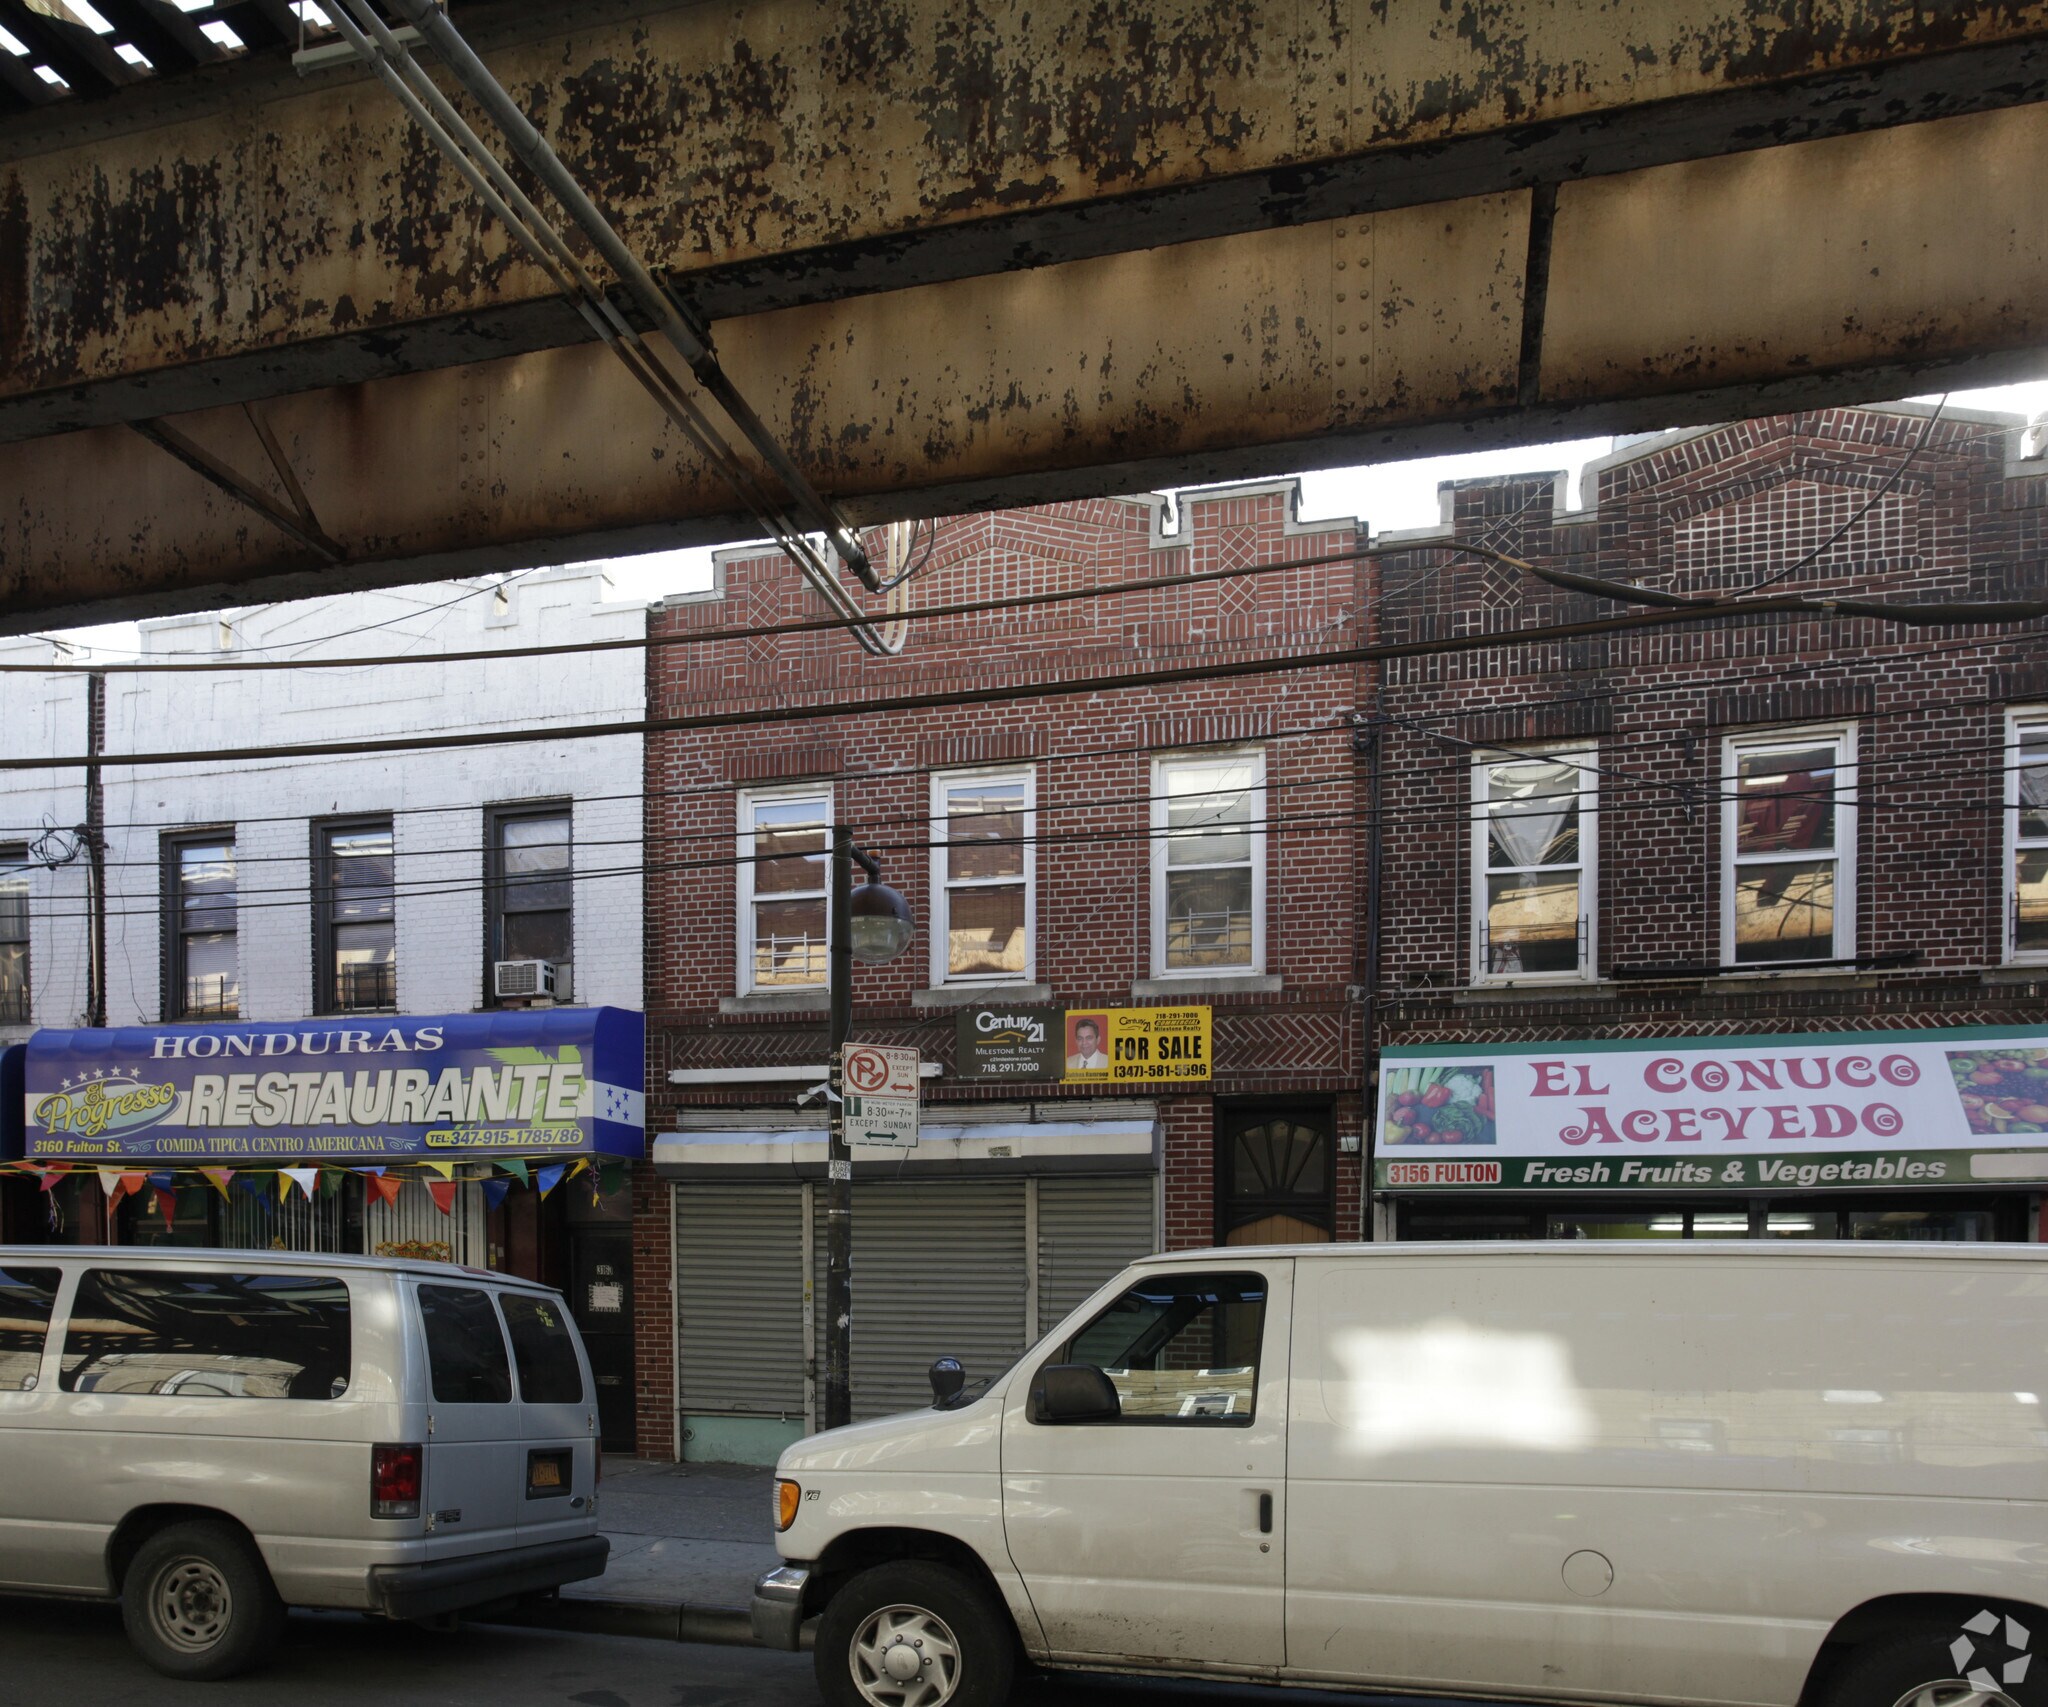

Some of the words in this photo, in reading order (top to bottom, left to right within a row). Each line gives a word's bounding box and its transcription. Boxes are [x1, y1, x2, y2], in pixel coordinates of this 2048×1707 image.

[975, 1011, 1033, 1032] Century
[1027, 1022, 1045, 1042] 21
[1119, 1016, 1146, 1026] Century
[1142, 1021, 1151, 1032] 21
[149, 1026, 444, 1059] HONDURAS
[975, 1047, 1015, 1056] MILESTONE
[1018, 1046, 1045, 1054] REALTY
[1114, 1037, 1149, 1061] FOR
[1158, 1035, 1202, 1060] SALE
[982, 1063, 1039, 1073] 718.291.7000
[1114, 1063, 1207, 1078] (347)-581-5596
[1528, 1061, 1610, 1097] EL
[1643, 1054, 1921, 1094] CONUCO
[85, 1079, 108, 1105] El
[187, 1062, 584, 1127] RESTAURANTE
[36, 1082, 175, 1136] Progresso
[850, 1119, 878, 1128] EXCEPT
[883, 1120, 912, 1129] SUNDAY
[1559, 1103, 1904, 1146] ACEVEDO
[34, 1140, 63, 1153] 3160
[66, 1140, 103, 1153] Fulton
[106, 1140, 122, 1153] St.
[156, 1138, 202, 1152] COMIDA
[208, 1137, 249, 1152] TIPICA
[252, 1137, 303, 1152] CENTRO
[307, 1136, 385, 1151] AMERICANA
[450, 1129, 580, 1145] 347-915-1785/86
[1390, 1165, 1430, 1183] 3156
[1435, 1163, 1498, 1182] FULTON
[1523, 1160, 1609, 1183] Fresh
[1620, 1160, 1712, 1183] Fruits
[1720, 1160, 1746, 1182] &
[1757, 1157, 1947, 1187] Vegetables
